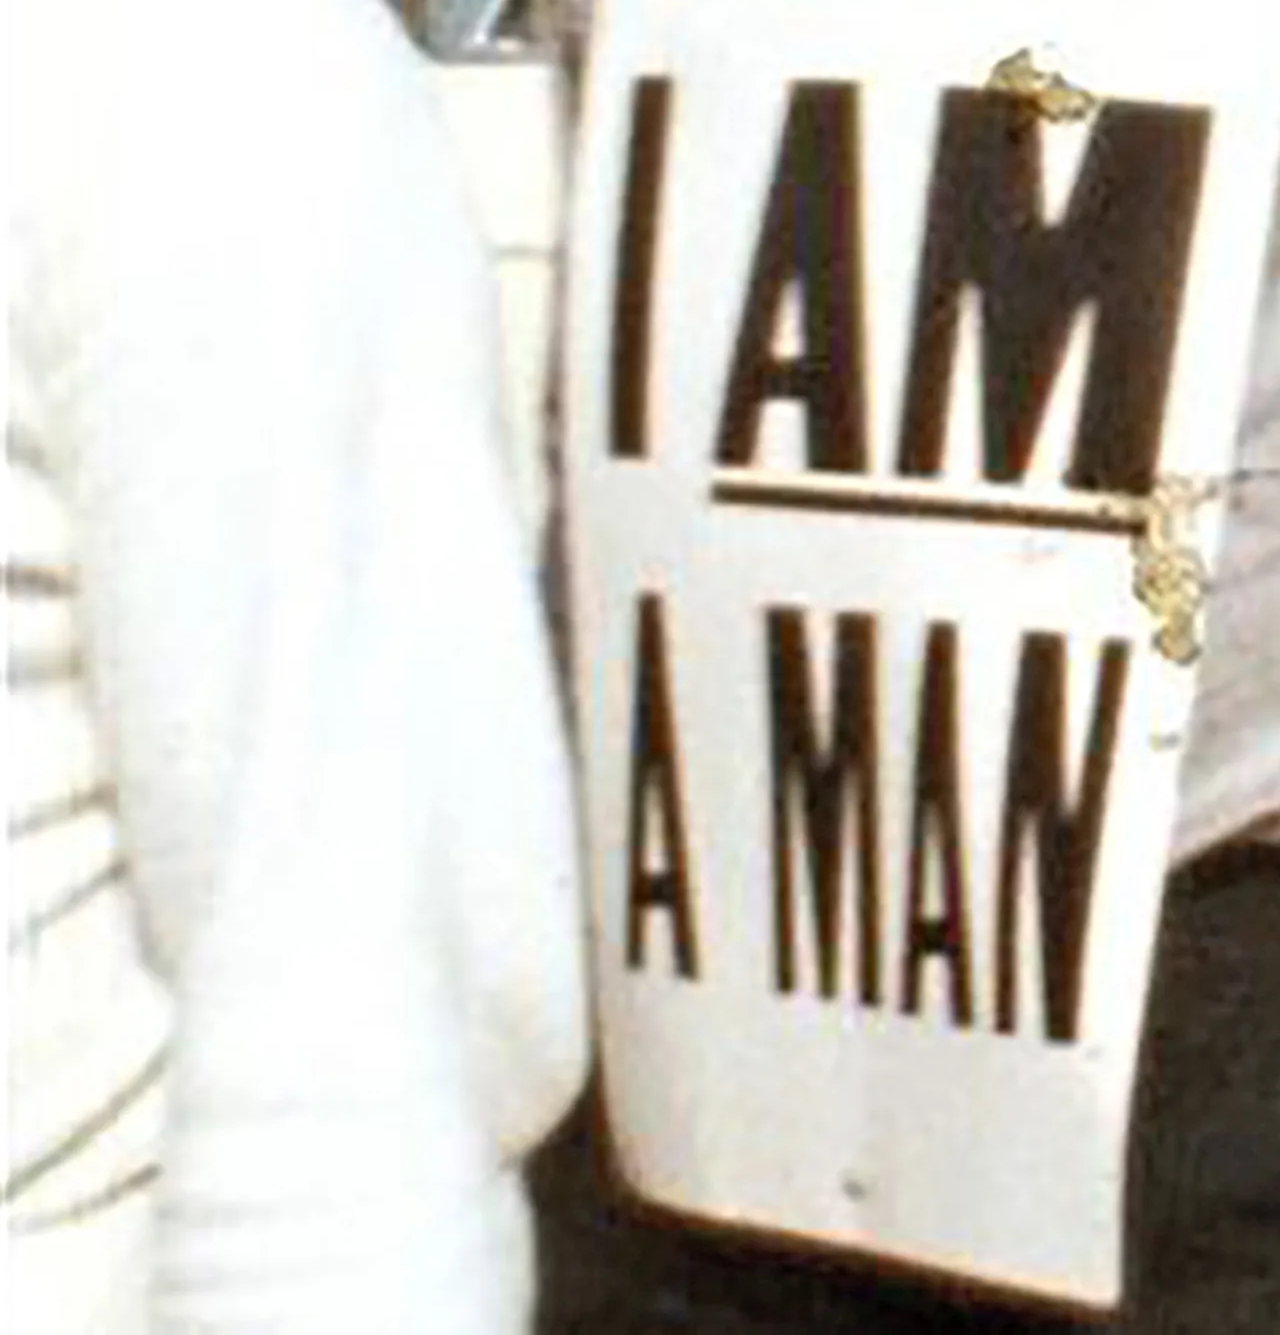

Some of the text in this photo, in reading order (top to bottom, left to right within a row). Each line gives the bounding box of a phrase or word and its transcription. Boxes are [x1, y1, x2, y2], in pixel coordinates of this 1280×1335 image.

[608, 74, 1216, 496] I AM
[622, 590, 1134, 1048] A MAN
